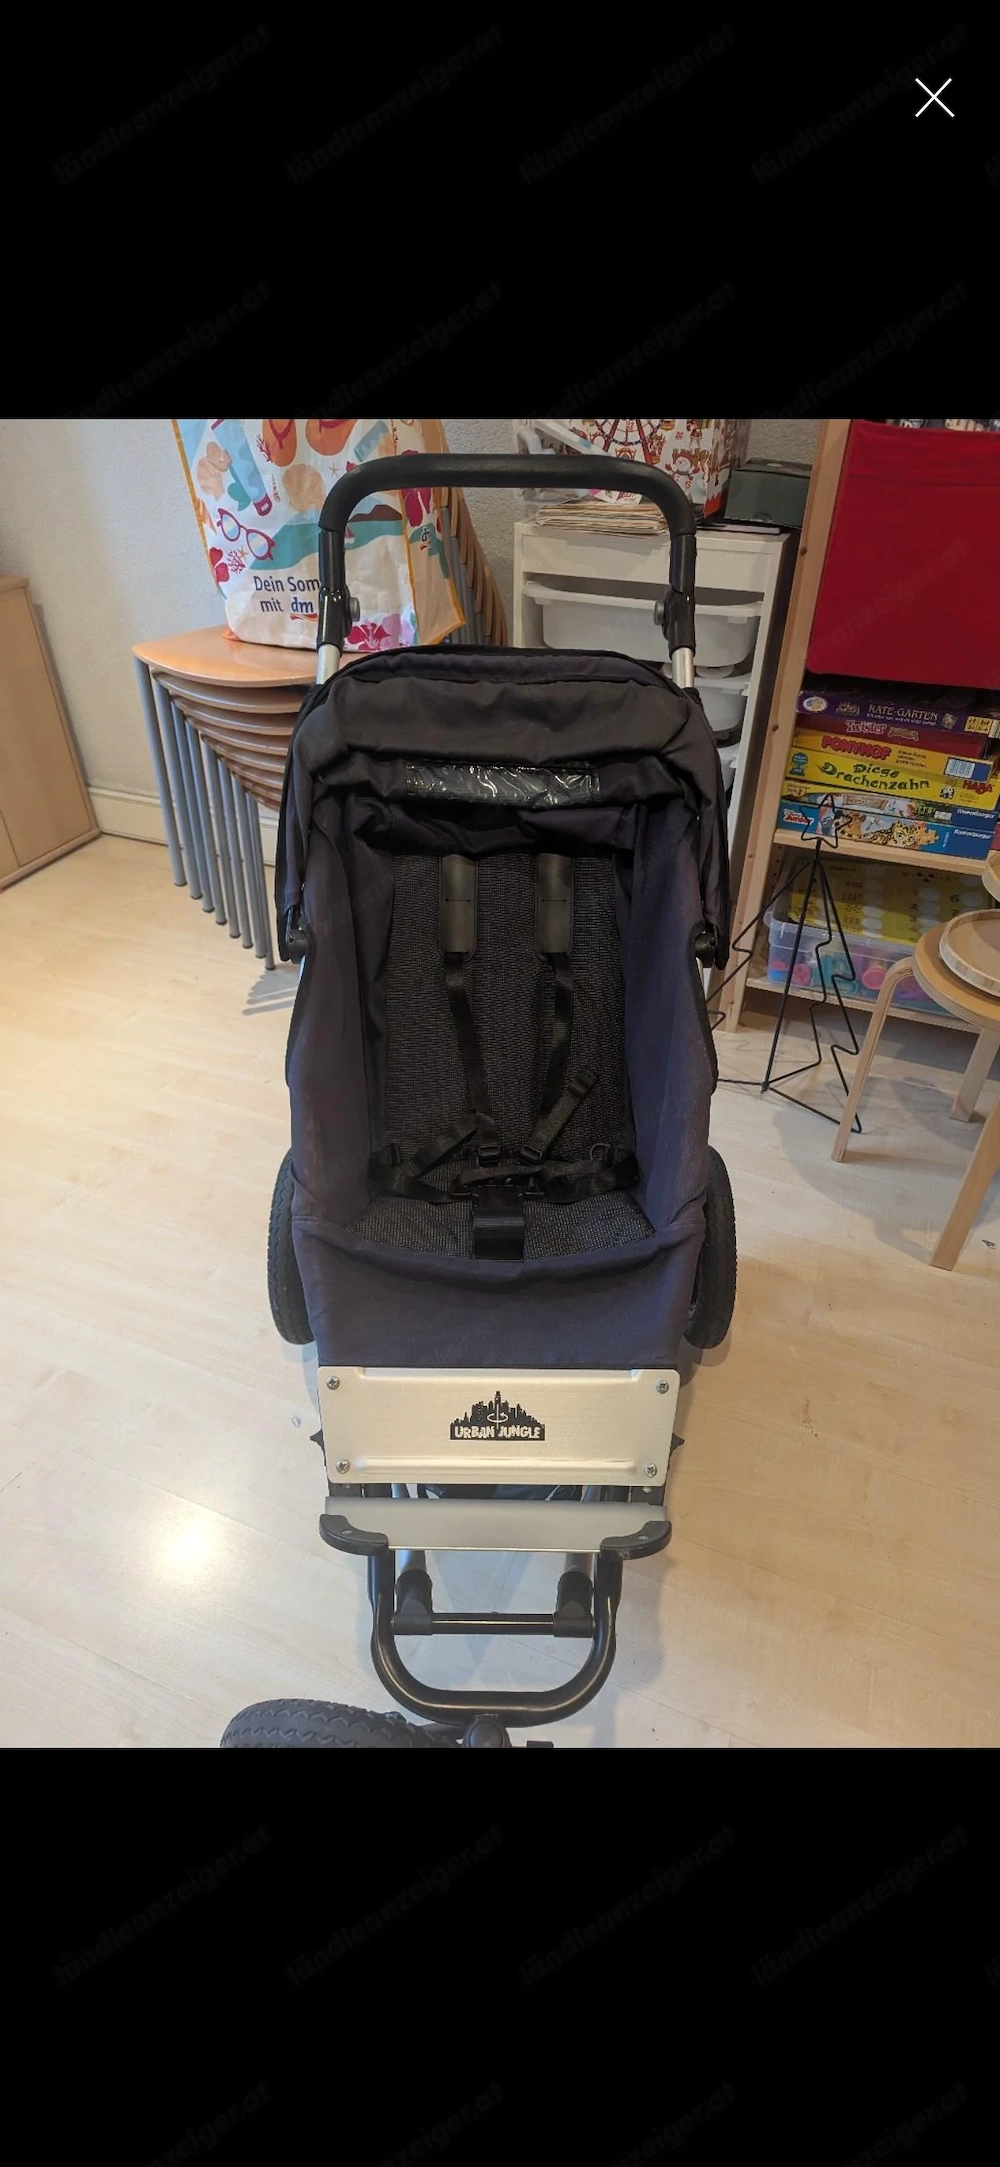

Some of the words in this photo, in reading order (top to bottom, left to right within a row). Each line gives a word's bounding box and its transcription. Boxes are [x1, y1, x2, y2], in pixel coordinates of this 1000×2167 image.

[253, 575, 285, 592] Dein
[287, 576, 320, 592] Som
[260, 597, 284, 612] mit
[291, 596, 314, 613] dm
[821, 735, 892, 761] PONYHOF
[818, 762, 930, 791] Drachenzahn
[853, 763, 900, 778] Diego
[962, 779, 993, 795] HABA
[454, 1425, 495, 1439] URBAN
[498, 1424, 540, 1439] JUNGLE
